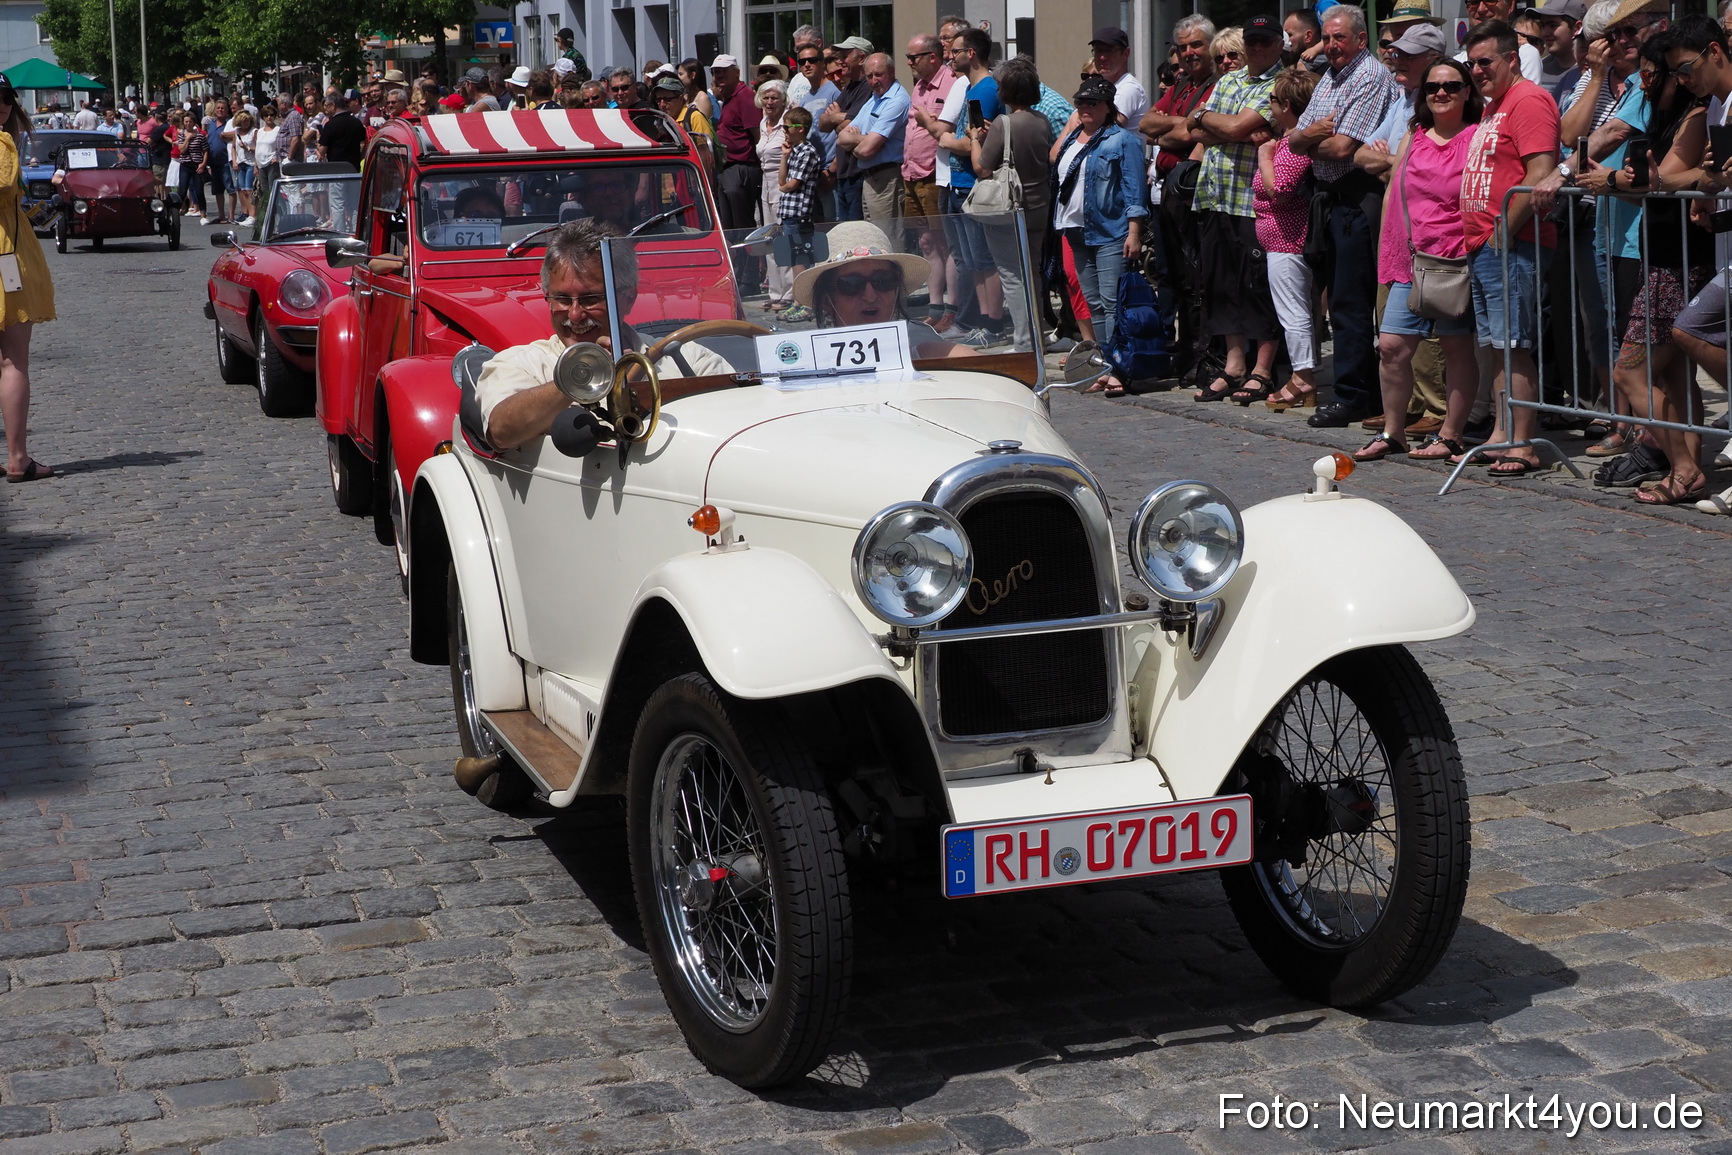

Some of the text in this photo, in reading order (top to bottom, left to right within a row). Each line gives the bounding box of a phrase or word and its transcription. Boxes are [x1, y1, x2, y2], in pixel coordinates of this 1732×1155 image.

[455, 232, 483, 246] 671
[830, 338, 881, 366] 731
[984, 829, 1050, 885] RH
[1085, 807, 1238, 873] 07019
[955, 869, 966, 885] D
